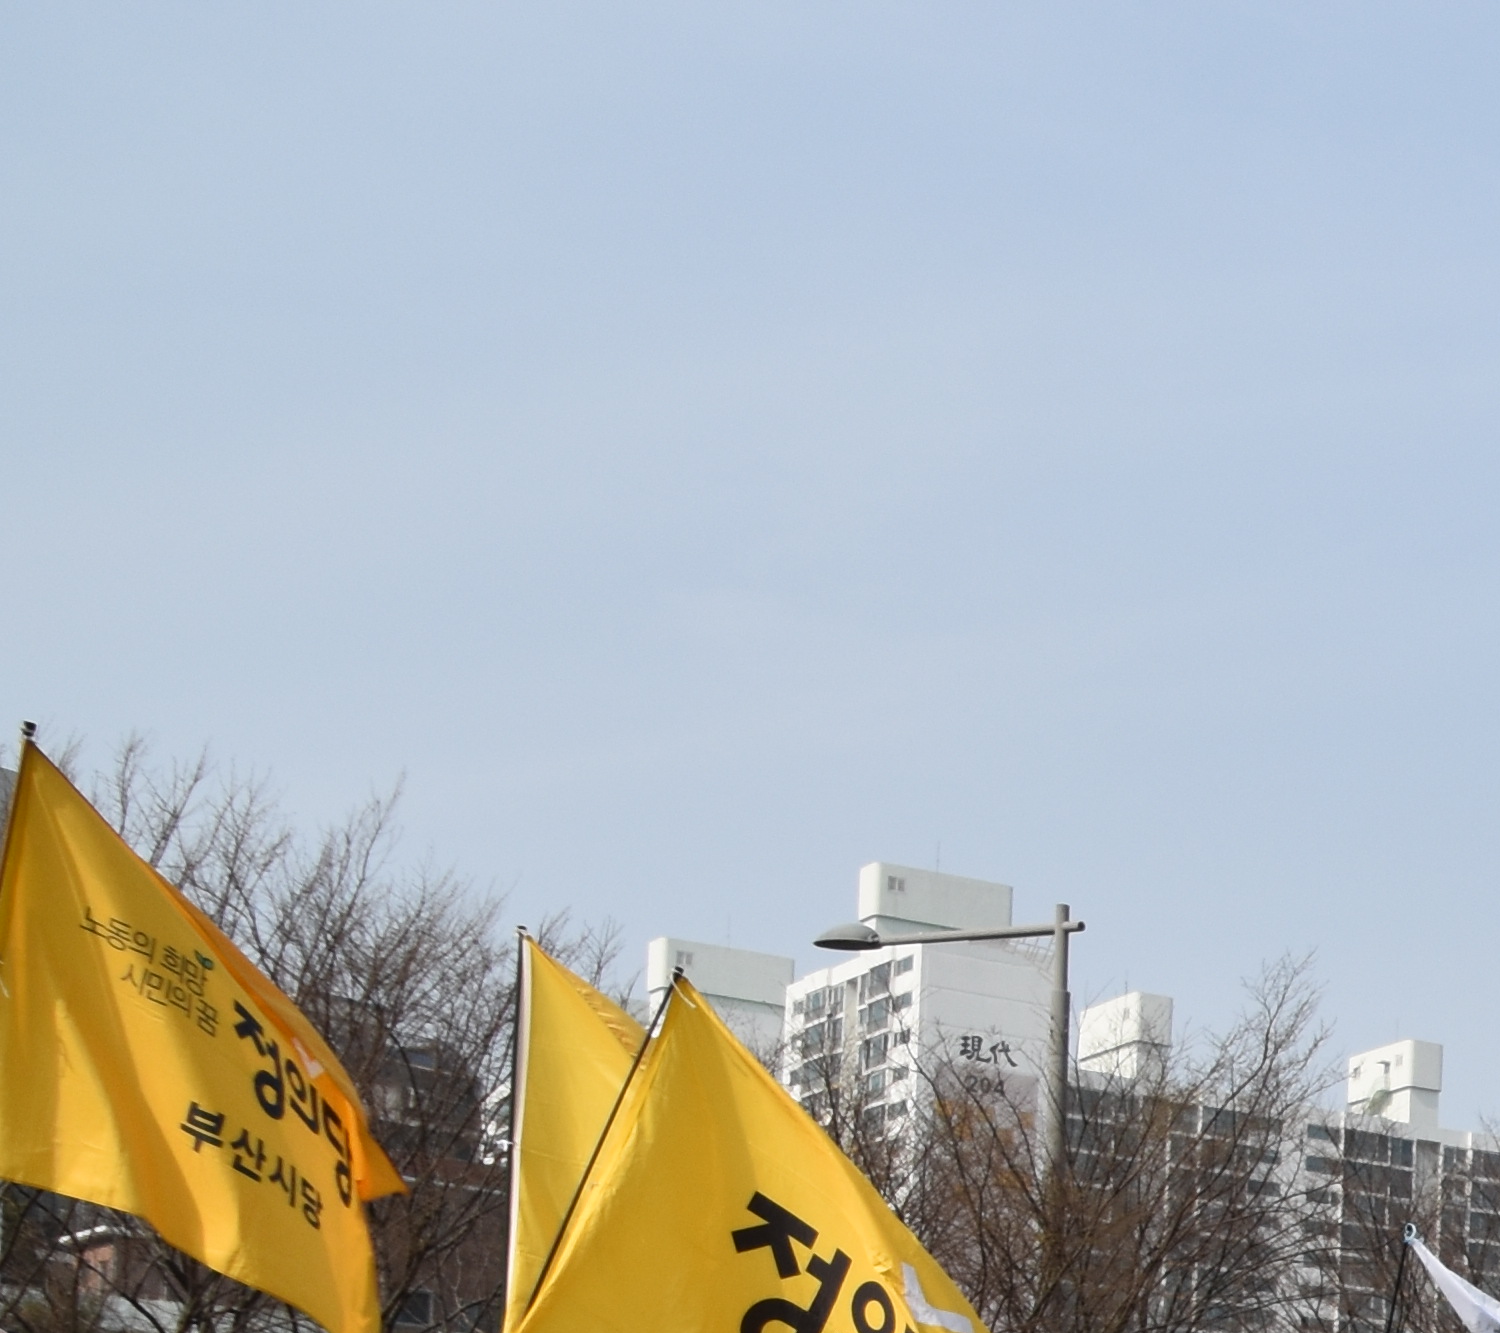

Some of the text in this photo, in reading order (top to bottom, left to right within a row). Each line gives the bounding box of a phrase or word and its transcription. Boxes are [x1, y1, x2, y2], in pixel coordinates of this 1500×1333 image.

[80, 907, 209, 998] 노동의 희망
[121, 964, 192, 1019] 시민의
[960, 1035, 1018, 1067] 現代
[965, 1075, 1004, 1097] 204
[233, 999, 354, 1208] 정의당
[180, 1101, 324, 1230] 부산시당
